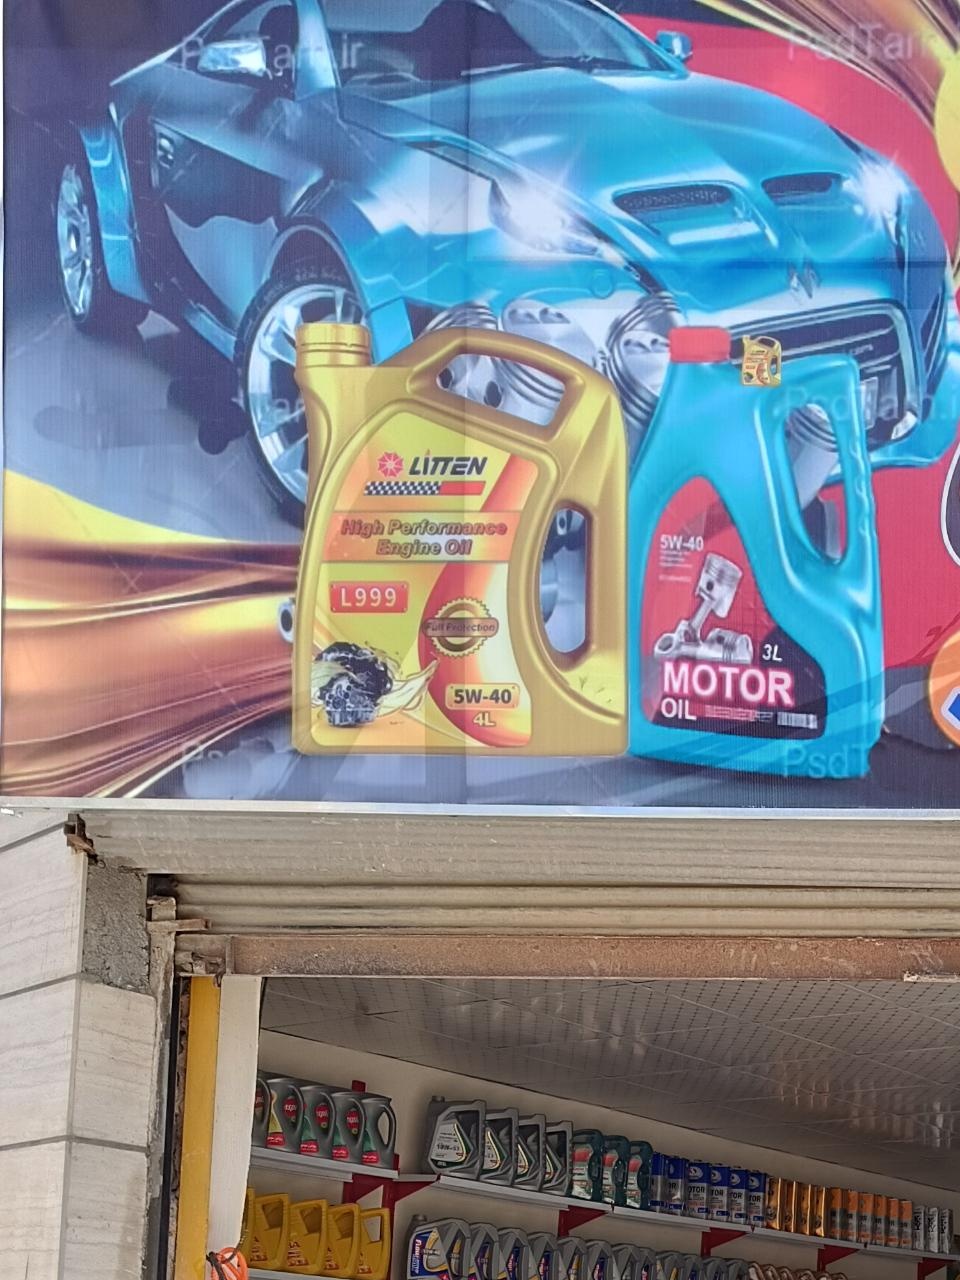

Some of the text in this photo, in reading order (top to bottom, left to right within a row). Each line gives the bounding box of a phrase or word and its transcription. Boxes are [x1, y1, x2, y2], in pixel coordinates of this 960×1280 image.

[340, 519, 508, 539] High Performance
[375, 539, 473, 559] Engine Oil
[660, 534, 704, 552] 5W-40
[340, 587, 398, 608] L999
[426, 622, 496, 633] Full Protection
[761, 643, 783, 663] 3L
[662, 661, 795, 706] MOTOR
[453, 687, 513, 704] 5W-40
[660, 697, 697, 721] OIL
[472, 711, 497, 728] 4L
